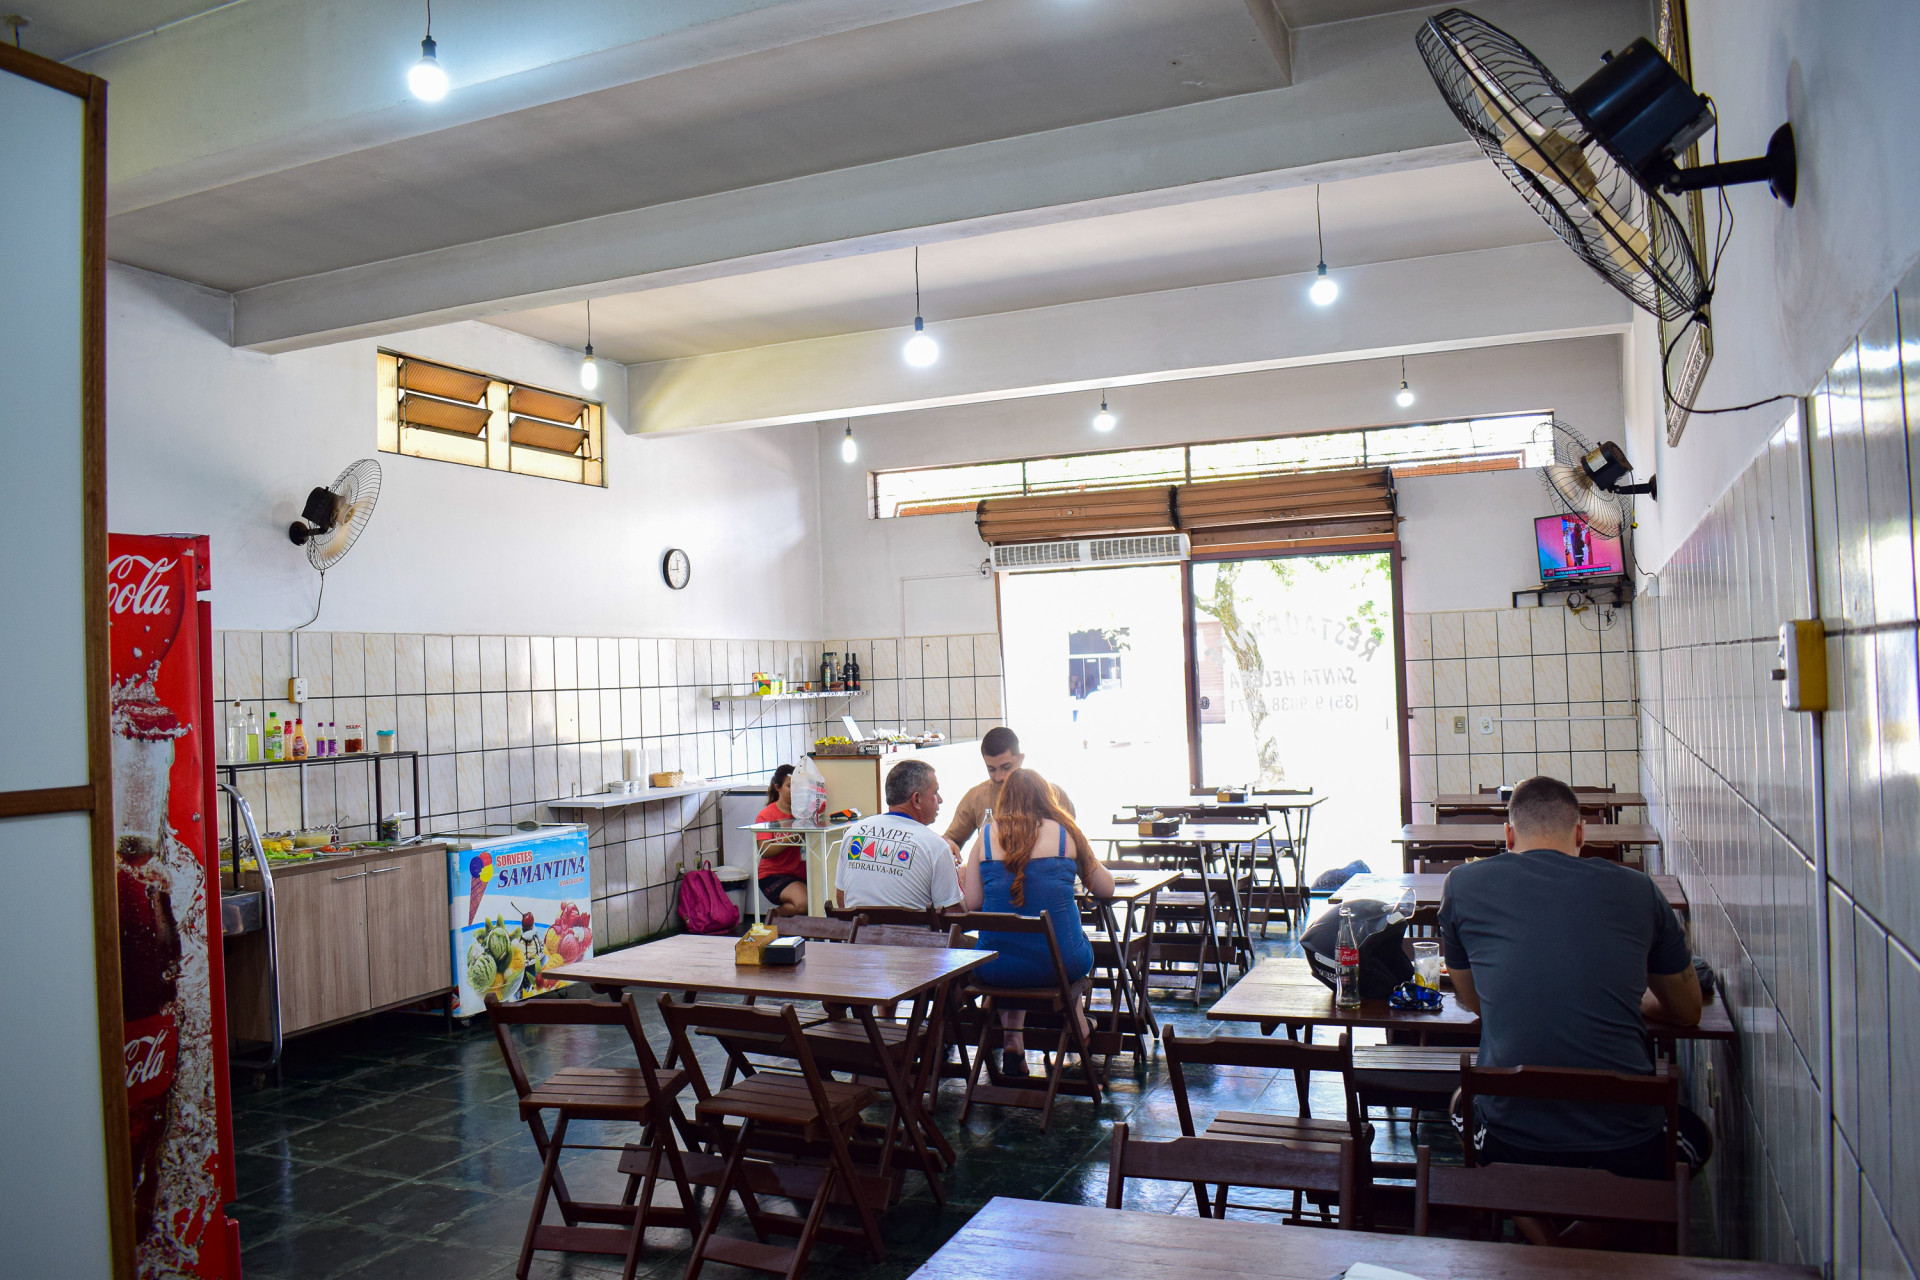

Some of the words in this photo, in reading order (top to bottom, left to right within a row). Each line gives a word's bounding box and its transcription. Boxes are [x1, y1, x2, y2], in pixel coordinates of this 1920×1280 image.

[858, 824, 914, 843] SAMPE
[496, 851, 533, 867] SORVETES
[498, 856, 585, 888] SAMANTINA
[848, 861, 904, 877] PEDRALVA-MG
